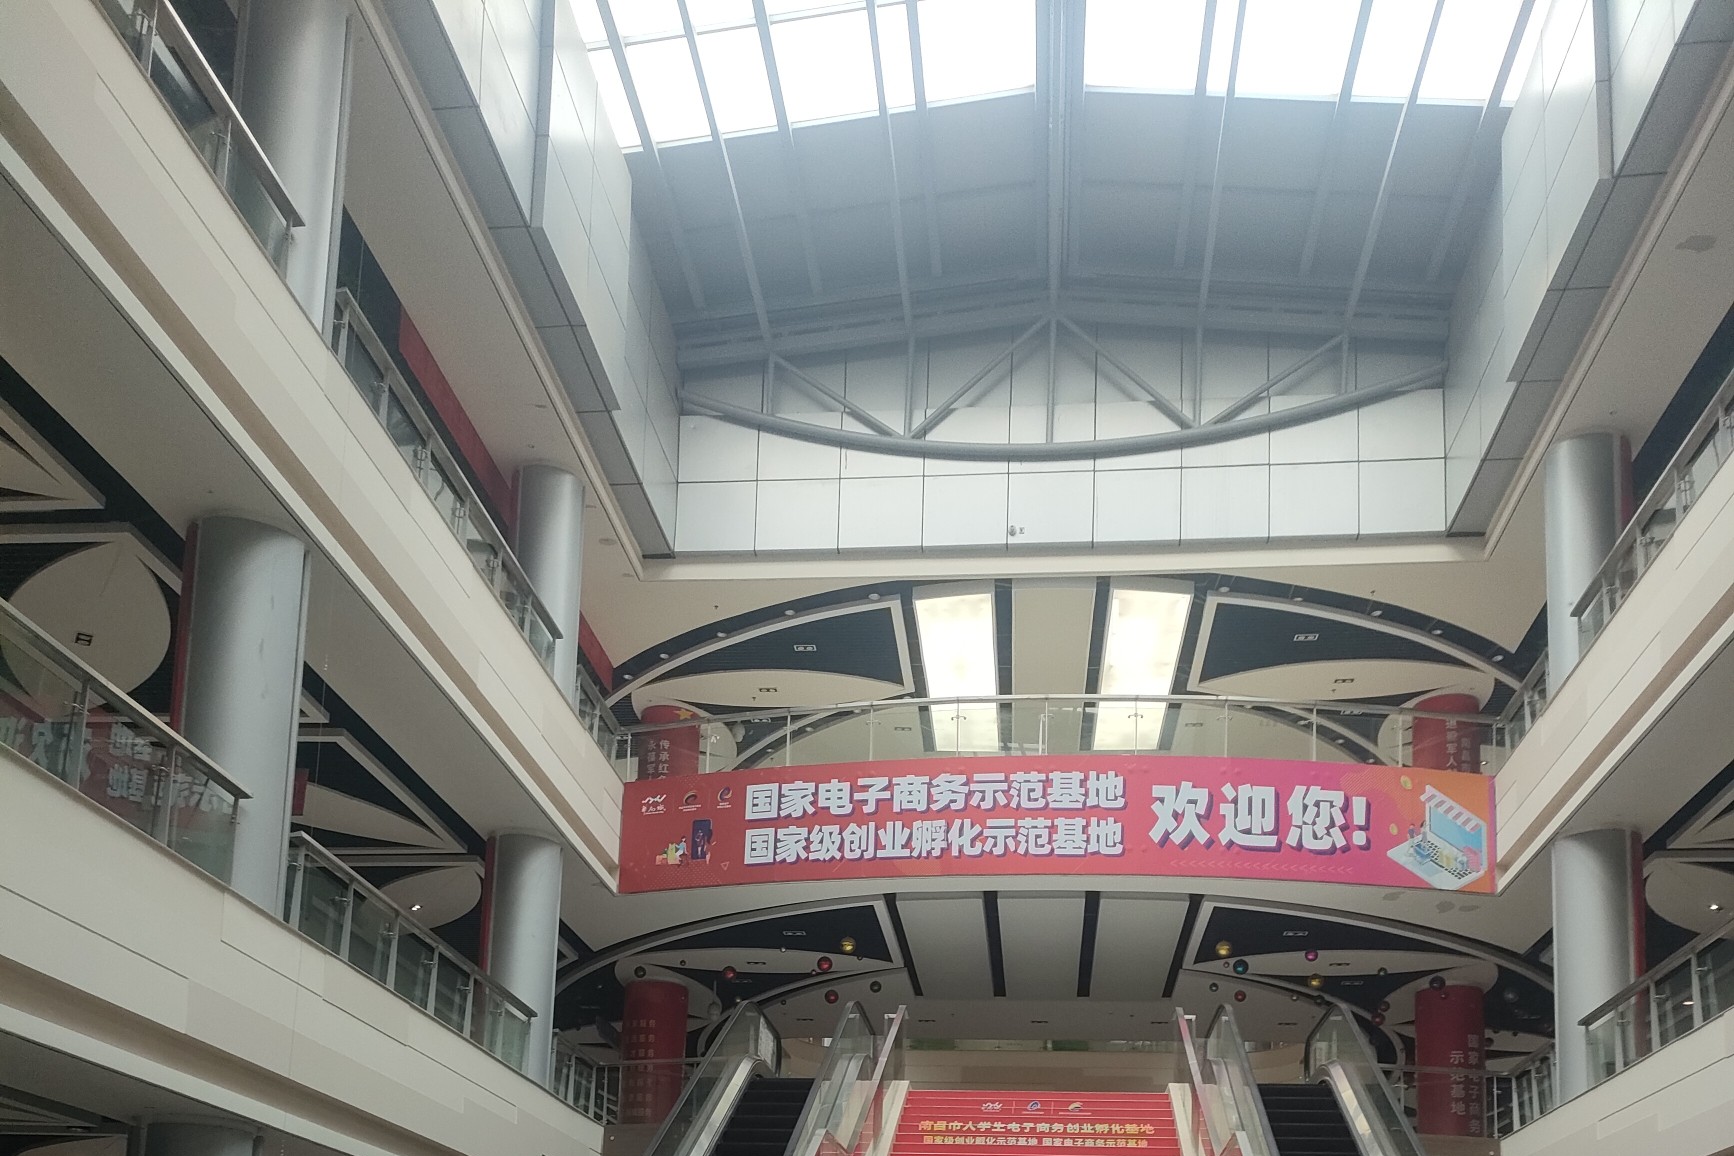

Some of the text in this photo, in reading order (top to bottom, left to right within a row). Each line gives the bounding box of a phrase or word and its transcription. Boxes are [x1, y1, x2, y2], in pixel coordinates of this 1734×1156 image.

[745, 770, 1126, 820] 国家电子商务示范基地
[744, 814, 1124, 865] 国家级创业孵化示范基地
